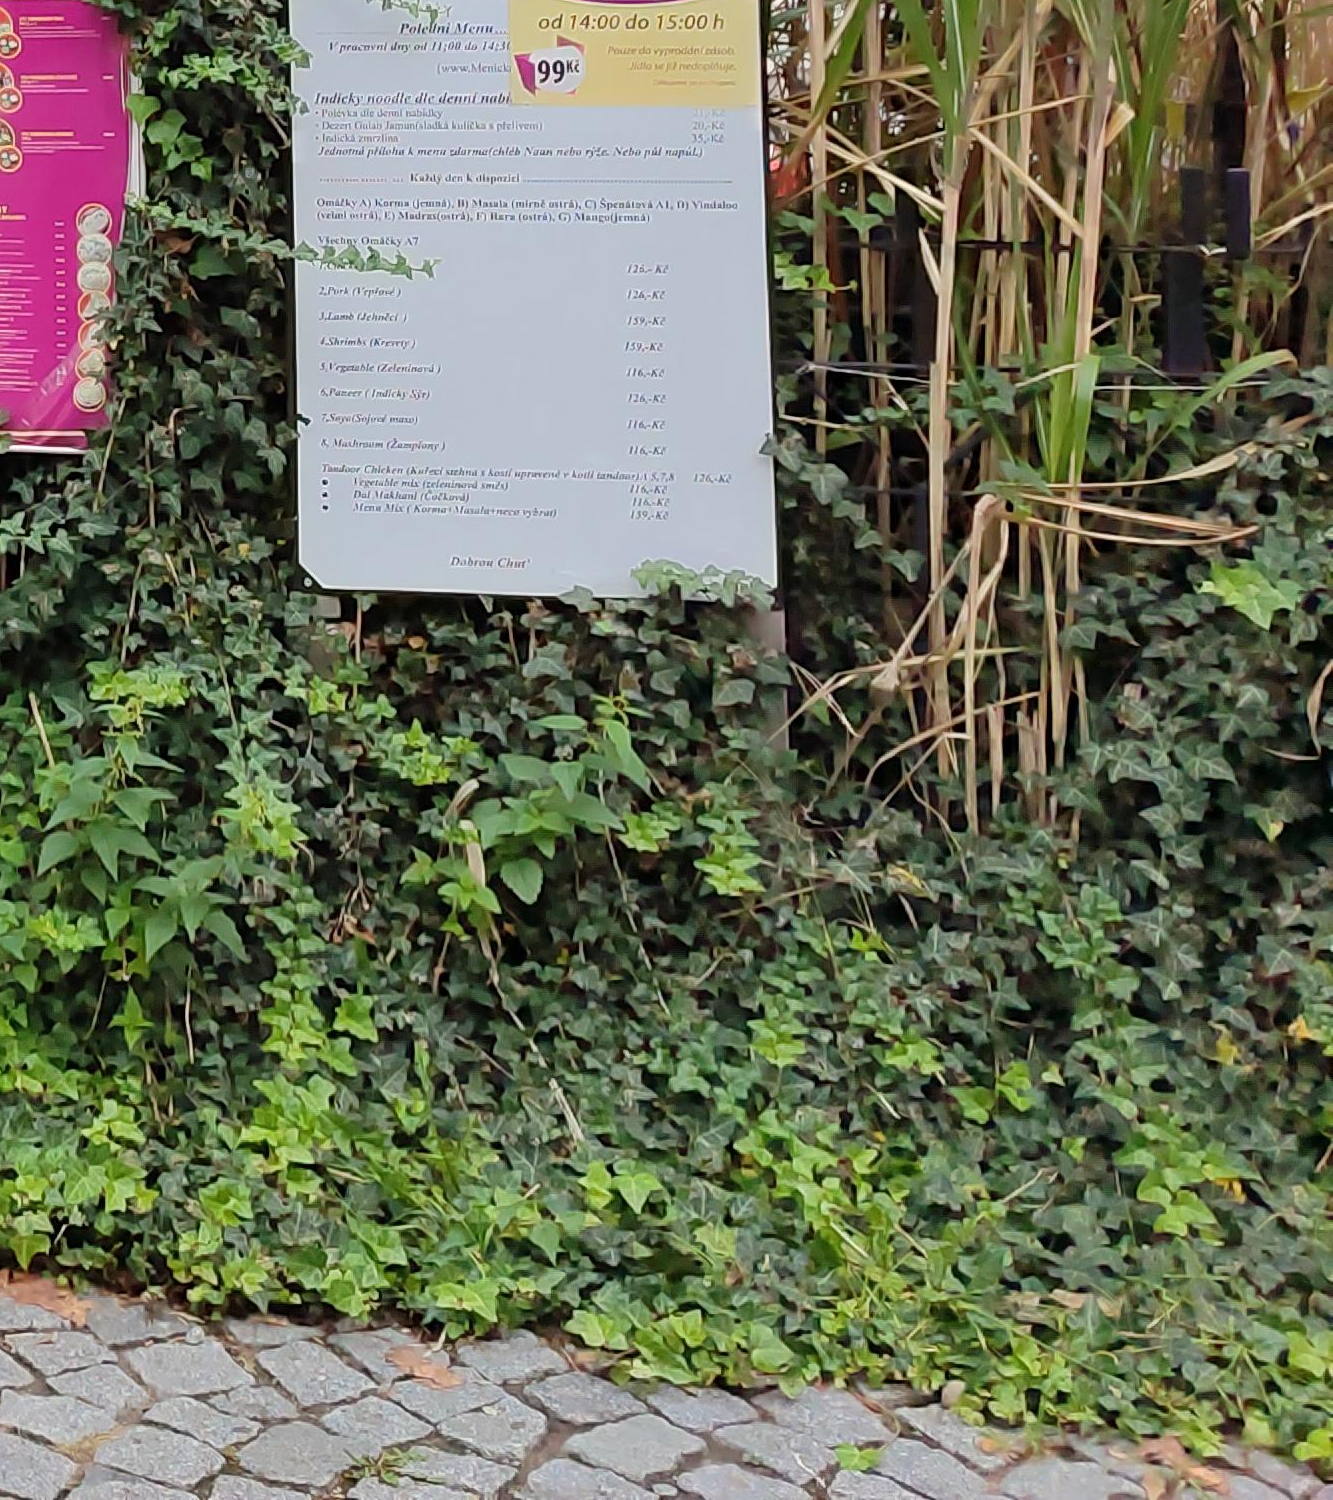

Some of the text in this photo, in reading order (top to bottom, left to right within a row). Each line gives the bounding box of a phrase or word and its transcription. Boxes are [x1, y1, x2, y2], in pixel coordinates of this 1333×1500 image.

[539, 14, 724, 30] od 14:00 do 15:00 h
